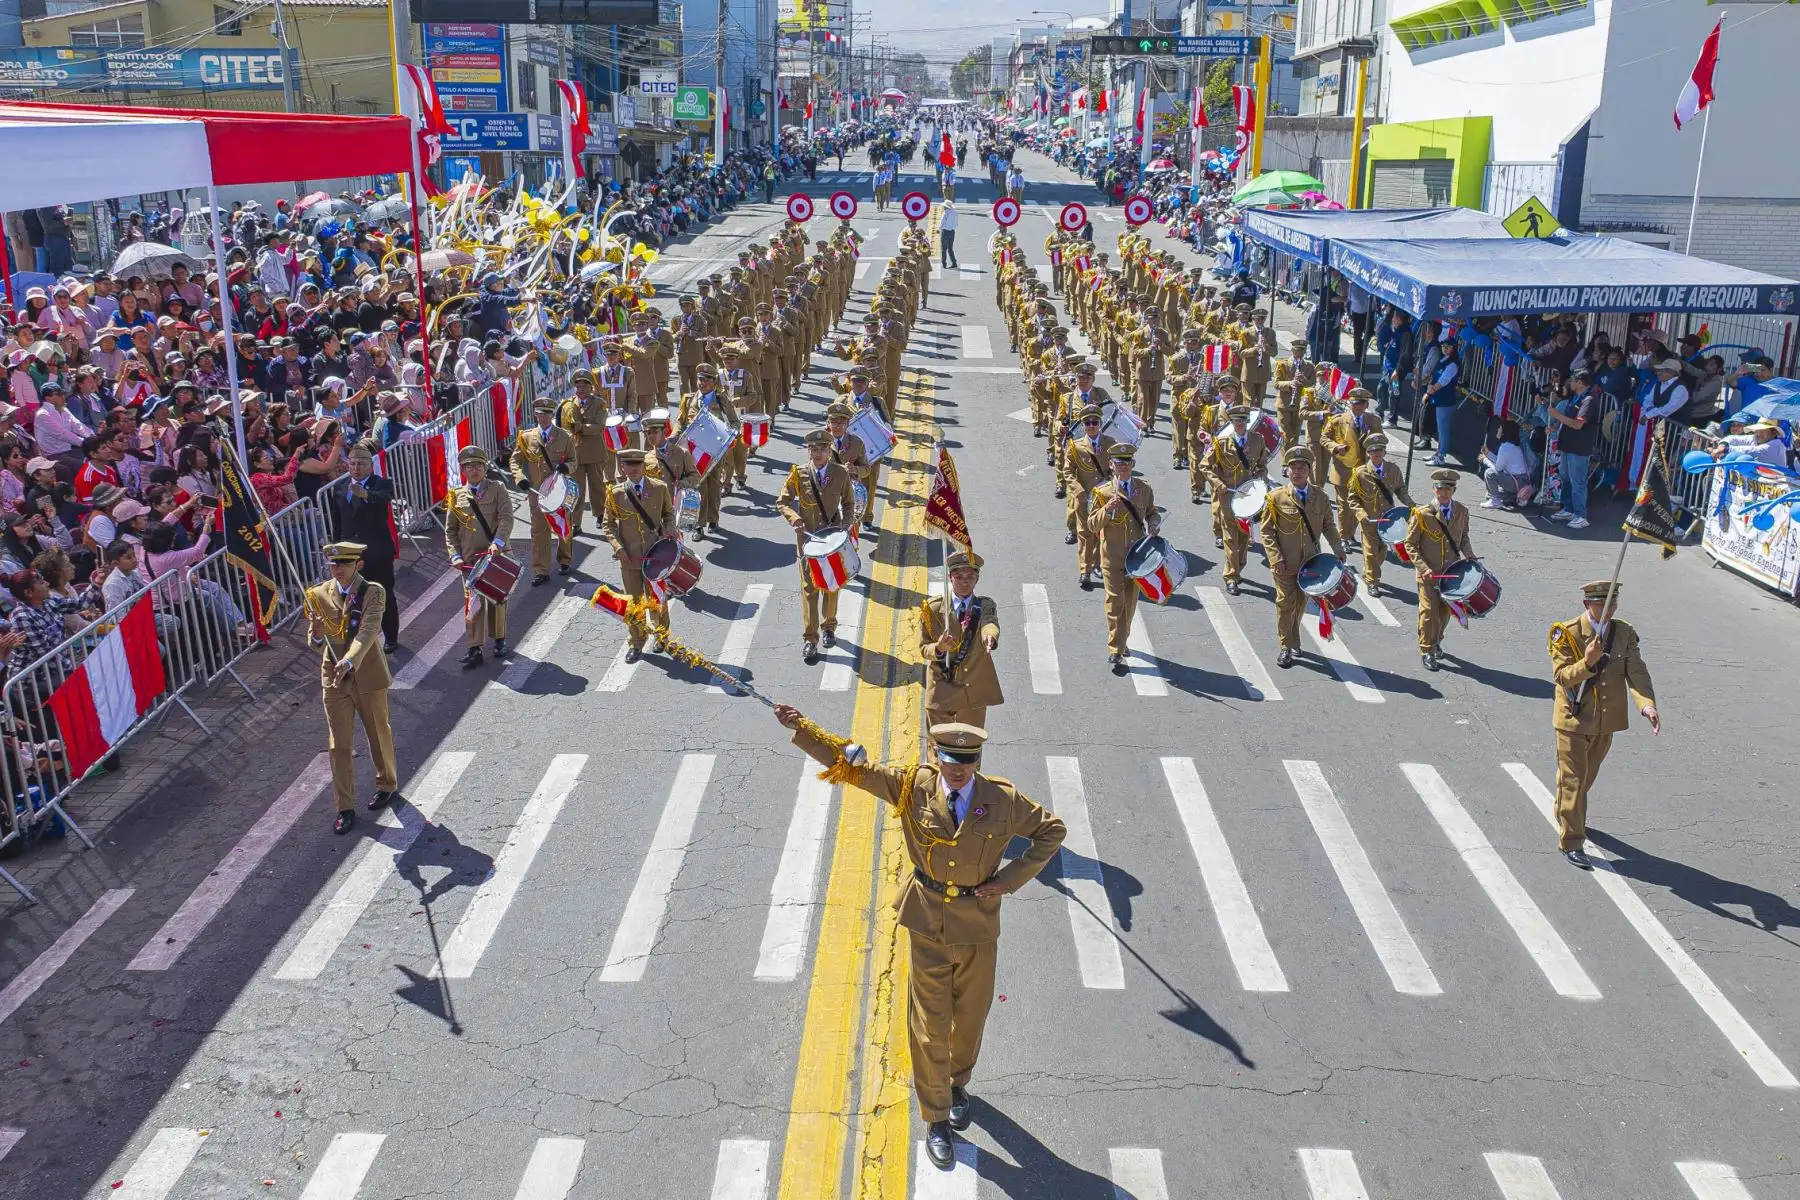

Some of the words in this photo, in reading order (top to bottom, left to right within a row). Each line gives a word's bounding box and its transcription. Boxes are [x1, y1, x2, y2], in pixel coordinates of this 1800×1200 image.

[26, 61, 43, 69] ES
[108, 61, 174, 70] EDUCACIÓN
[641, 82, 677, 93] CITEC
[1473, 288, 1577, 312] MUNICIPALIDAD
[1580, 287, 1662, 308] PROVINCIAL
[1666, 287, 1686, 307] DE
[1687, 287, 1758, 309] AREQUIPA
[944, 505, 966, 531] PUESTO
[237, 525, 263, 553] 2012
[1727, 540, 1756, 561] Delgado
[1756, 554, 1788, 578] Espinoa
